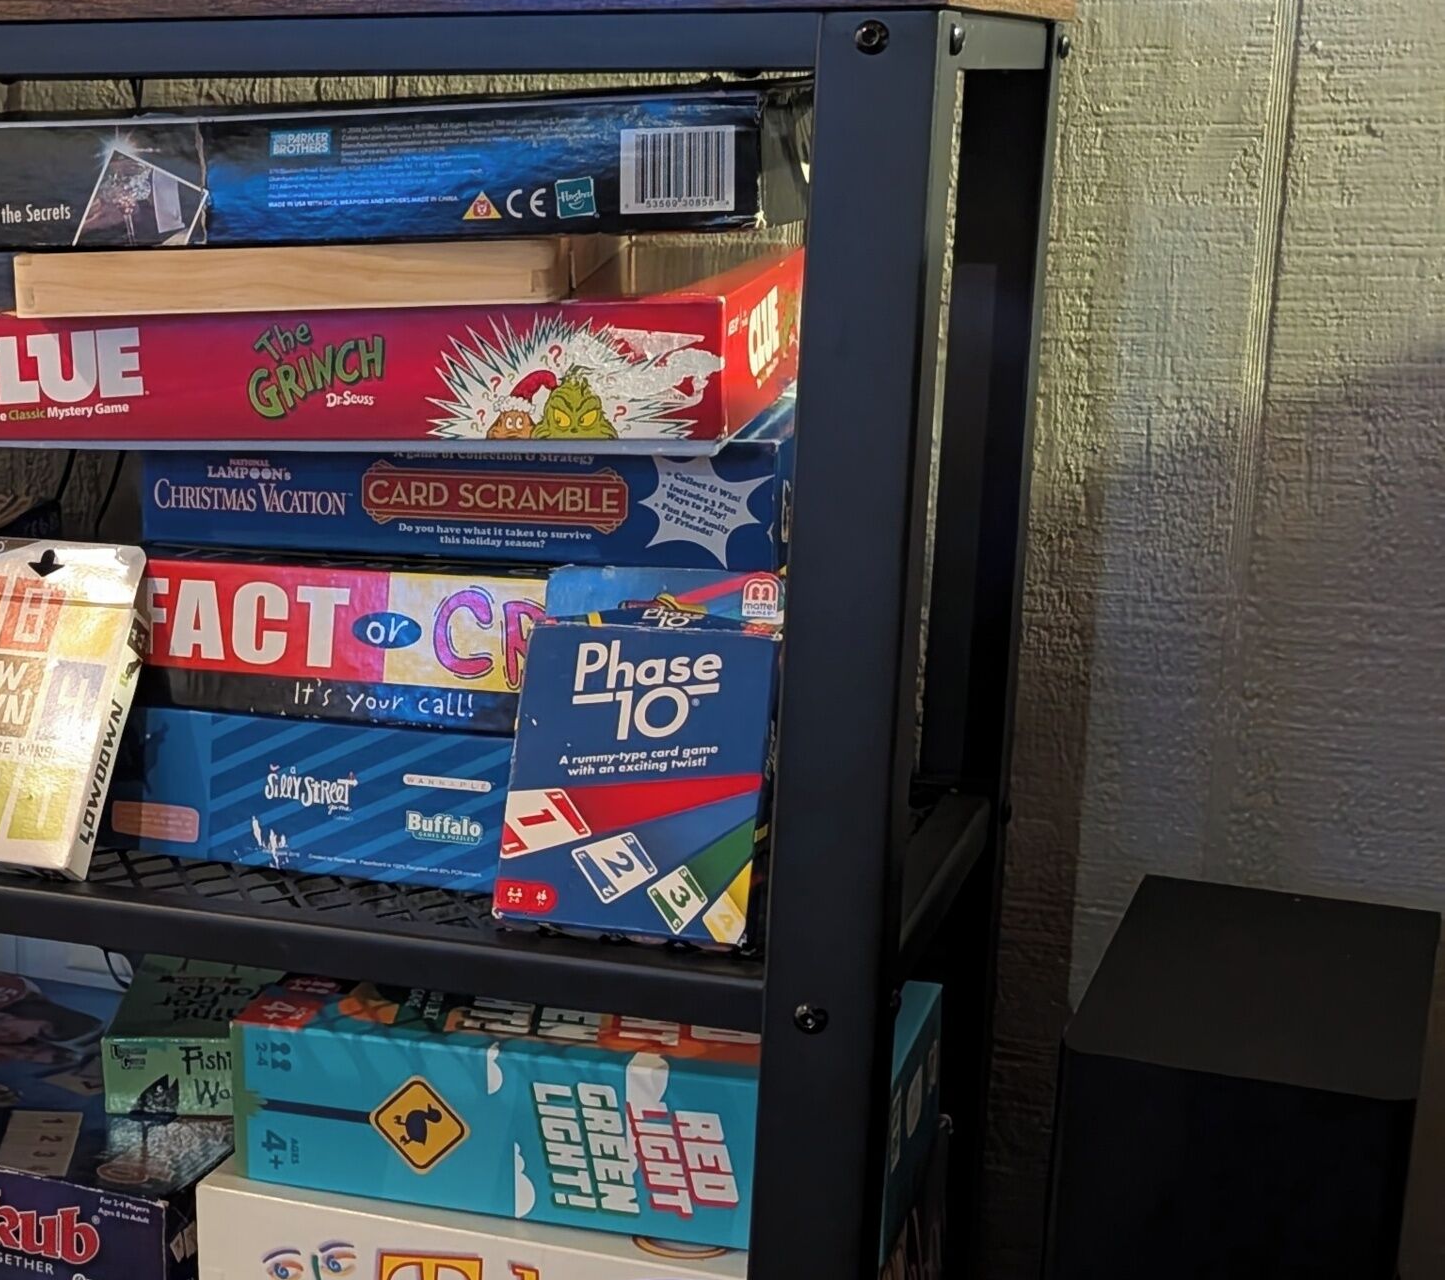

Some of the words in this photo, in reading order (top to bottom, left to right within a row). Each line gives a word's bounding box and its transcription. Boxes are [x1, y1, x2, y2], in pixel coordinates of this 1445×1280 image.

[272, 142, 330, 156] BROTHERS
[287, 131, 329, 144] PARKER
[0, 205, 22, 225] the
[25, 203, 72, 224] Secrets
[253, 318, 313, 362] The
[748, 285, 780, 378] CLUE
[247, 334, 387, 419] GRINCH
[7, 407, 46, 422] Classic
[46, 405, 94, 422] Mystery
[95, 402, 130, 416] Game
[229, 458, 270, 468] NATIONAL
[539, 453, 595, 466] Strategy
[153, 477, 257, 513] CHRISTMAS
[258, 481, 346, 517] VACATION
[367, 479, 449, 508] CARD
[458, 483, 620, 514] SCRAMBLE
[668, 483, 710, 505] Includes
[717, 501, 738, 516] Fun
[673, 471, 708, 491] Collect
[719, 488, 742, 504] Win!
[660, 501, 682, 517] Fun
[681, 506, 697, 522] for
[697, 512, 732, 535] Family
[665, 490, 691, 508] Ways
[691, 499, 703, 511] to
[702, 504, 729, 522] Play!
[398, 523, 414, 534] Do
[414, 525, 435, 536] you
[436, 524, 462, 535] have
[463, 526, 492, 537] what
[494, 526, 504, 537] it
[505, 527, 535, 538] takes
[537, 528, 549, 539] to
[550, 530, 593, 541] survive
[439, 535, 461, 546] this
[462, 535, 503, 549] holiday
[503, 537, 547, 549] season?
[674, 515, 715, 538] Friends!
[12, 586, 52, 644] 8
[641, 607, 705, 620] Phase
[743, 600, 778, 612] mattel
[145, 577, 350, 671] FACT
[365, 616, 406, 645] or
[573, 639, 723, 692] Phase
[292, 680, 330, 708] It's
[345, 688, 406, 714] your
[417, 692, 476, 719] call!
[614, 686, 690, 741] 10
[558, 755, 569, 766] A
[572, 750, 648, 765] rummy-type
[650, 745, 680, 759] card
[682, 745, 719, 761] game
[567, 763, 596, 777] with
[598, 763, 616, 775] an
[618, 759, 668, 774] exciting
[670, 756, 708, 769] twist!
[79, 697, 124, 846] LOWDOWN
[406, 811, 483, 837] Buffalo
[445, 832, 476, 843] PUZZLES
[601, 850, 637, 879] 2
[668, 885, 692, 909] 3
[178, 1045, 232, 1075] Fishi
[260, 1128, 288, 1170] 4+
[530, 1081, 598, 1213] LIGHT!
[576, 1081, 642, 1216] GREEN
[626, 1101, 694, 1218] LIGHT
[674, 1110, 741, 1210] RED
[97, 1206, 114, 1218] Ages
[130, 1213, 150, 1225] Adult
[99, 1196, 112, 1206] For
[125, 1200, 151, 1214] Players
